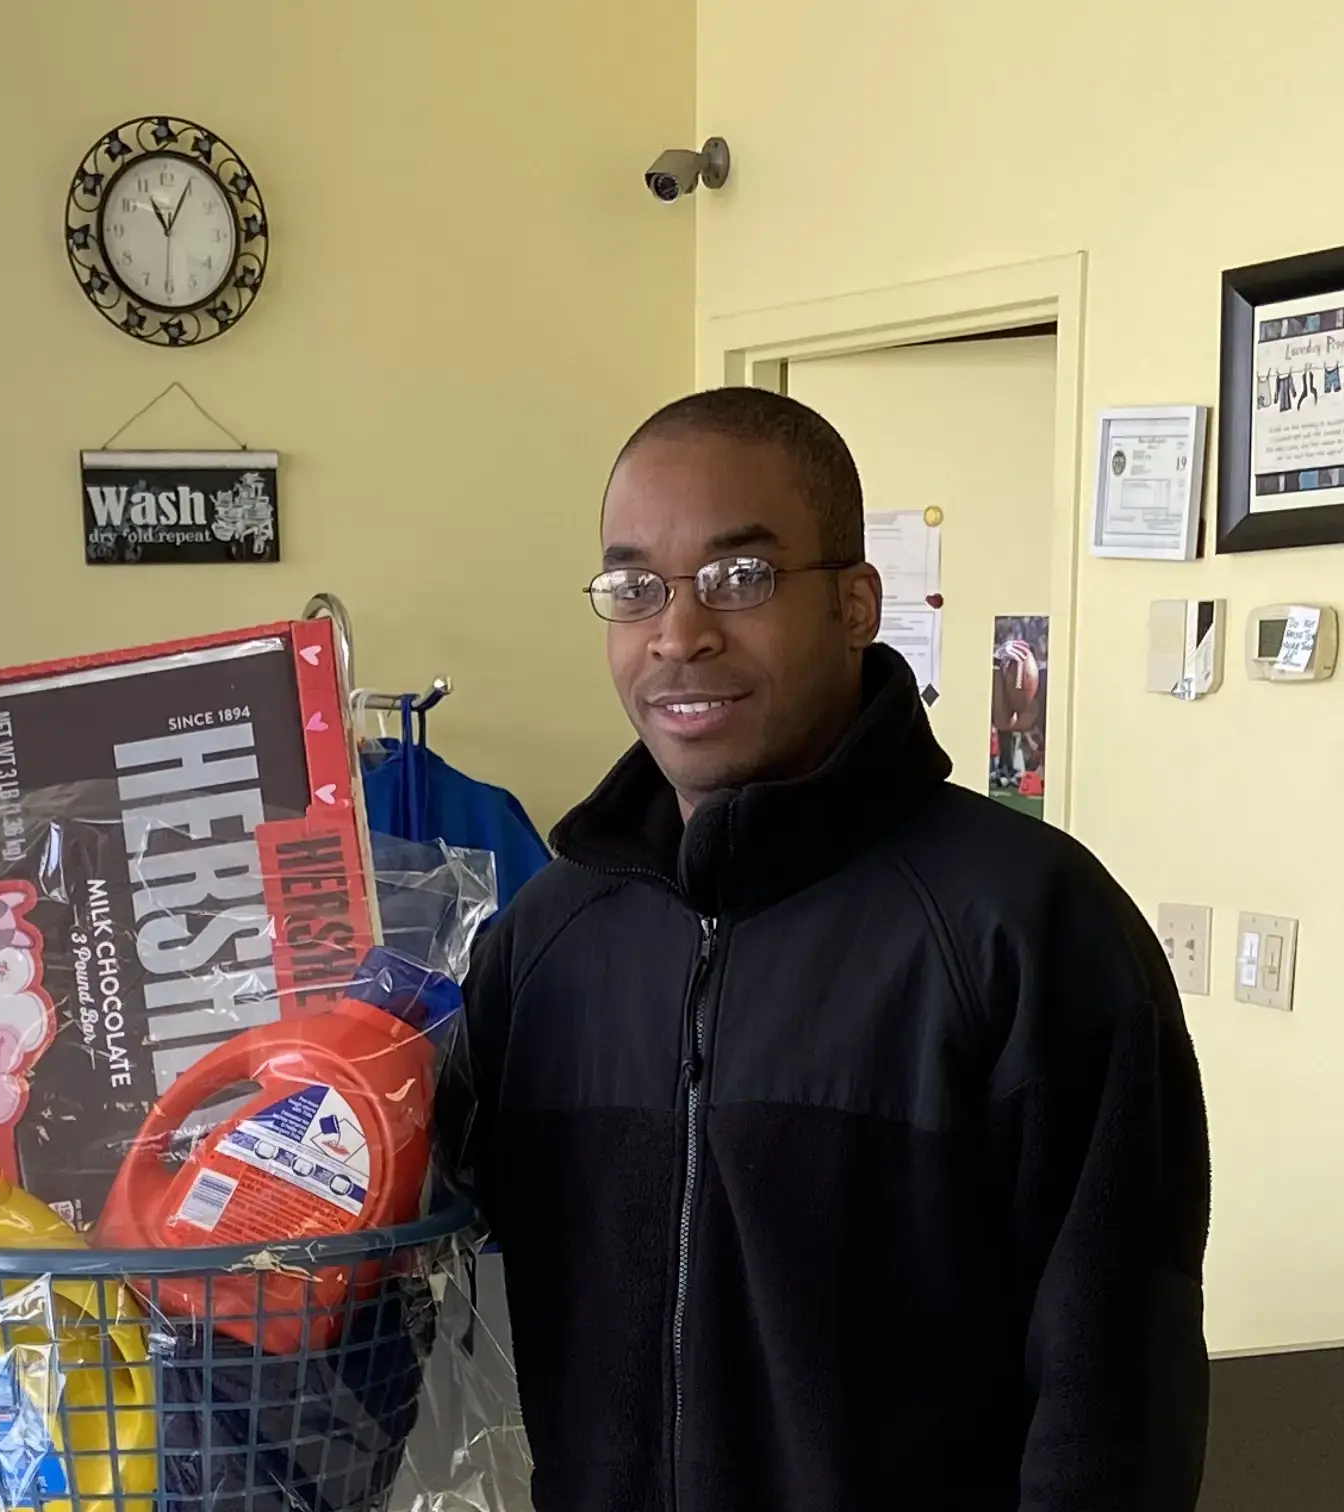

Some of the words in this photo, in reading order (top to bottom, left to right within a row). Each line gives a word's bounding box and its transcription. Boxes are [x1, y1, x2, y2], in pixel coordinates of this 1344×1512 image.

[86, 486, 207, 526] Wash
[88, 528, 116, 546] dry
[157, 529, 213, 546] repeat
[168, 711, 214, 732] SINCE
[218, 705, 252, 723] 1894
[87, 878, 114, 937] MILK
[71, 932, 88, 944] 3
[72, 946, 94, 1008] Pound
[80, 1006, 99, 1045] Bar
[96, 940, 132, 1088] CHOCOLATE
